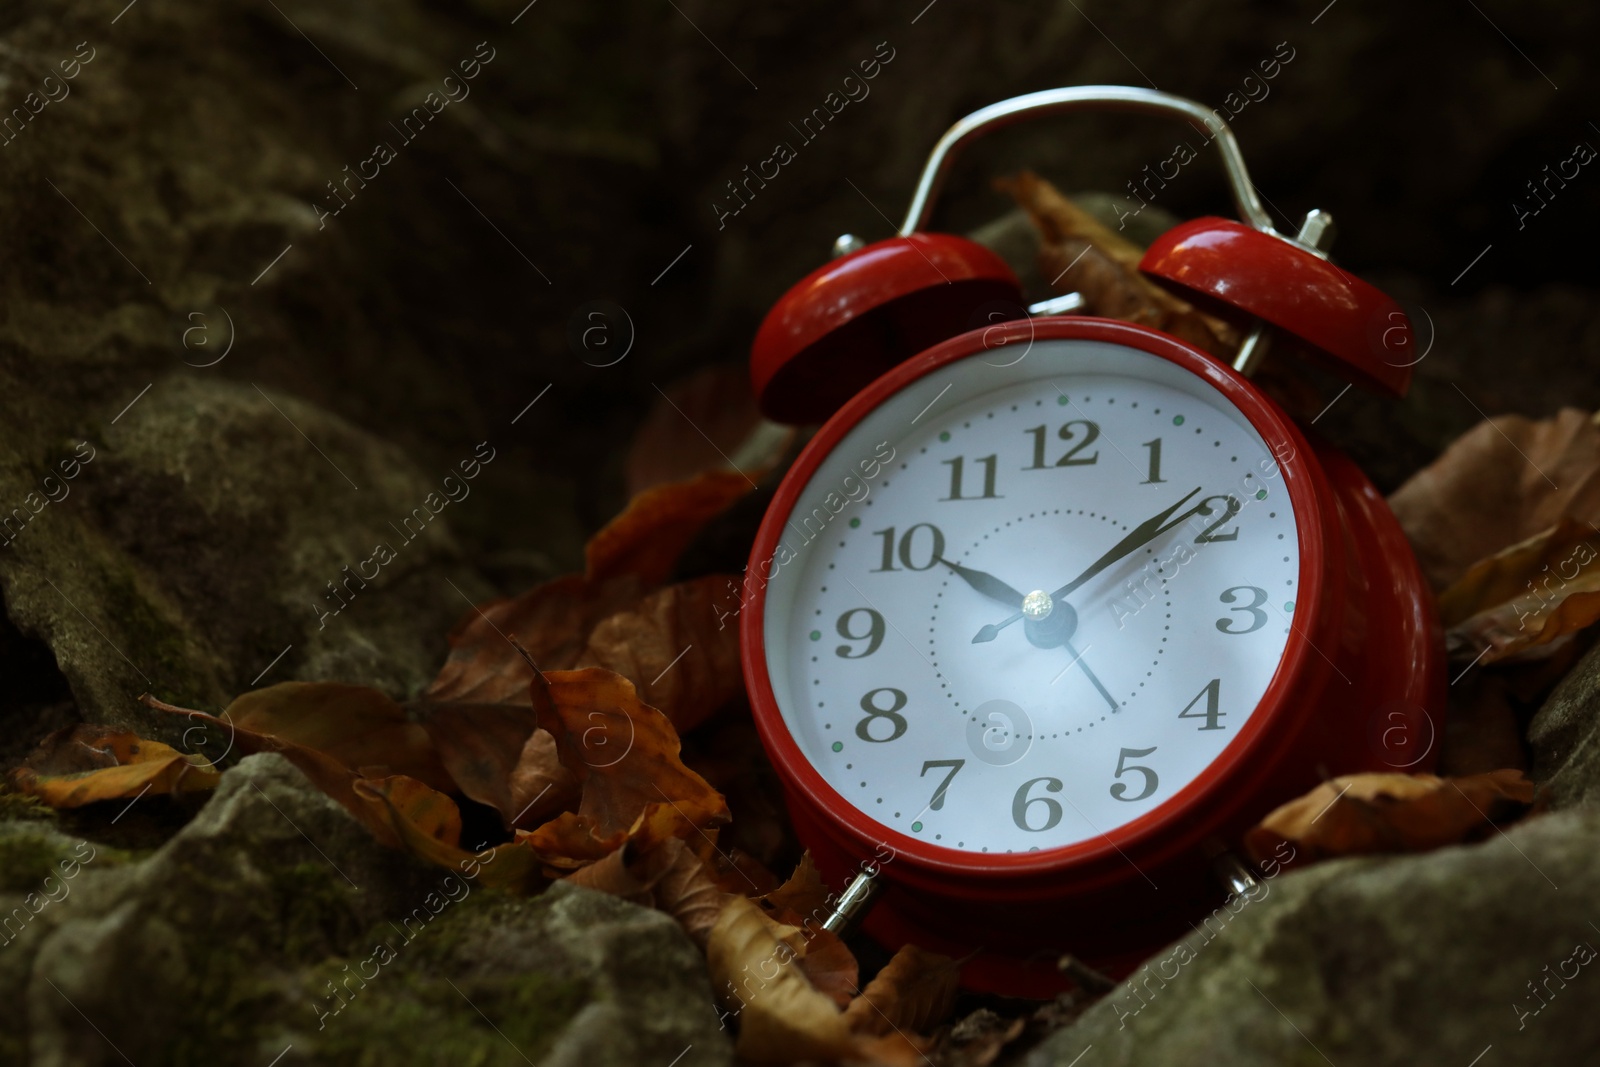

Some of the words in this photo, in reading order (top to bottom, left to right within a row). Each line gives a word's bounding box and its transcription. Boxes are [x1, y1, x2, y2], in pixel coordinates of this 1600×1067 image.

[1020, 420, 1100, 470] 12
[1139, 437, 1168, 485] 1
[938, 454, 1006, 502] 11
[1193, 494, 1241, 544] 2
[868, 523, 946, 573] 10
[835, 608, 886, 659] 9
[1215, 585, 1269, 635] 3
[855, 687, 908, 743] 8
[1177, 678, 1228, 732] 4
[919, 758, 966, 812] 7
[1109, 745, 1159, 802] 5
[1011, 776, 1064, 832] 6
